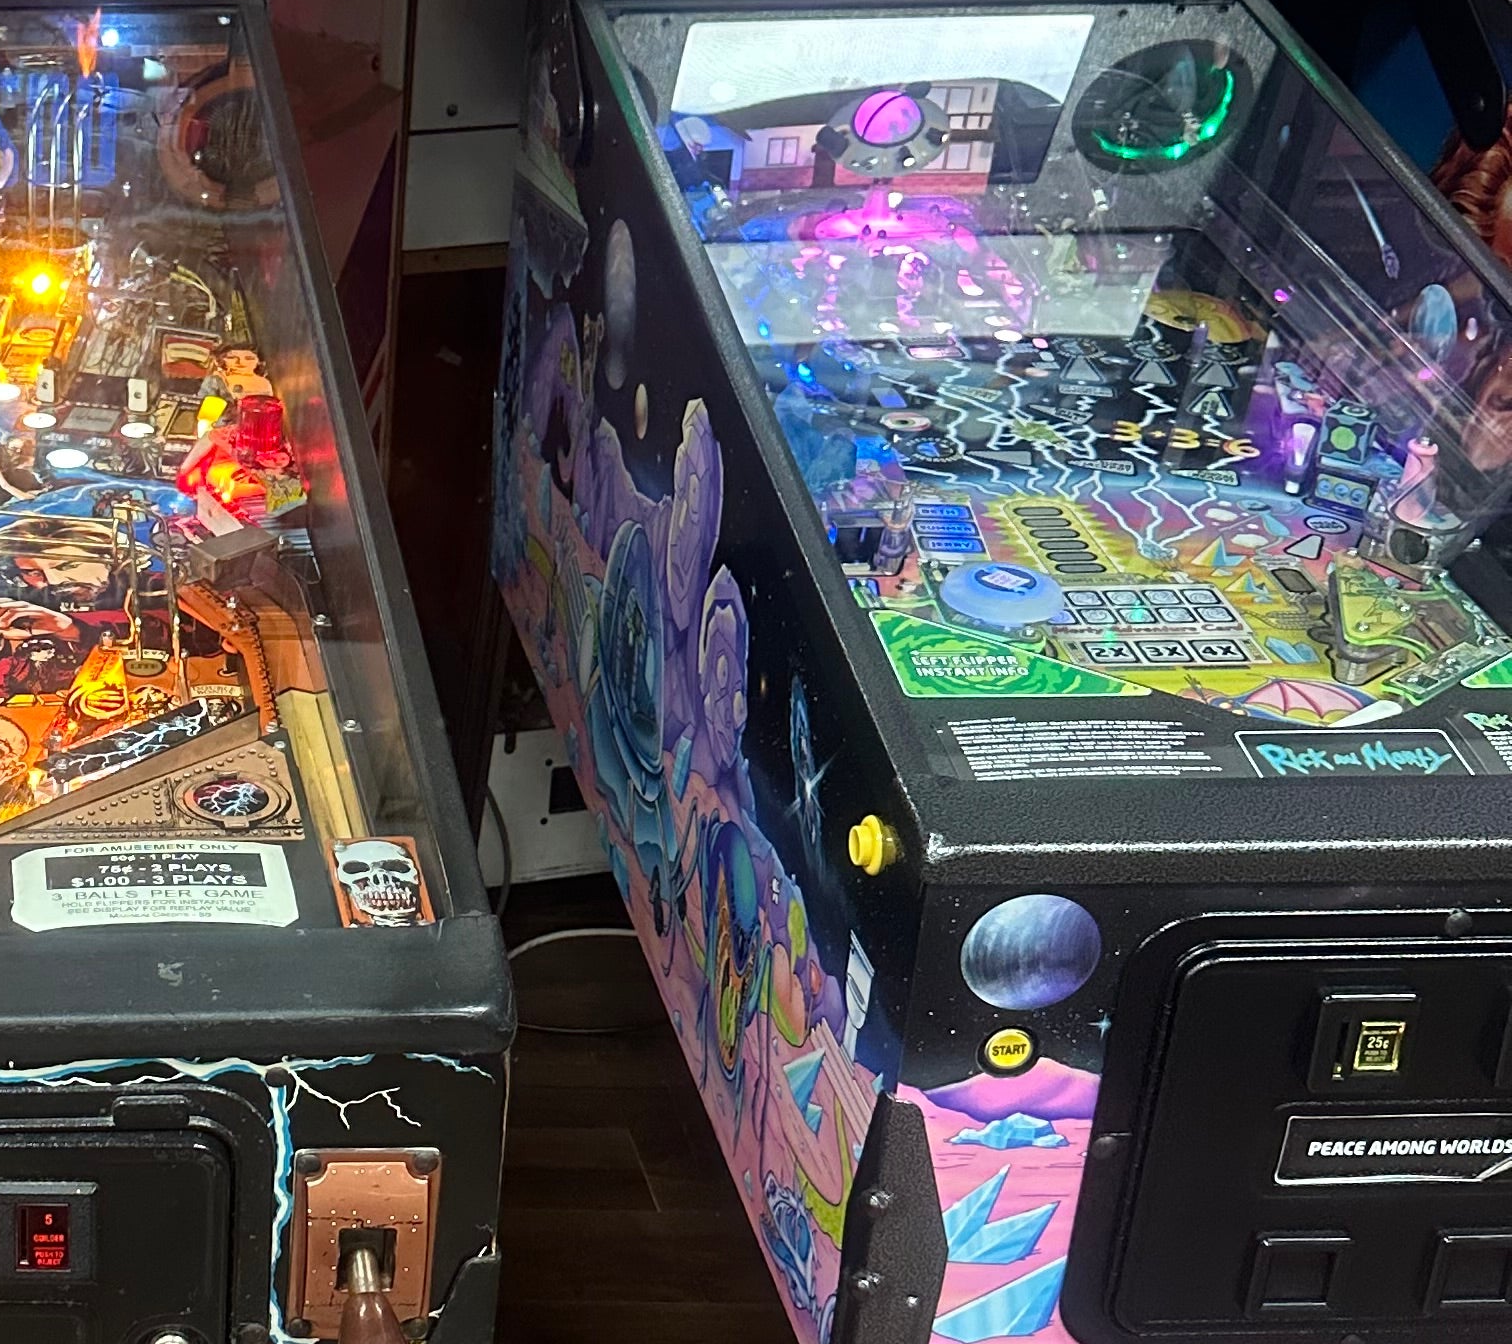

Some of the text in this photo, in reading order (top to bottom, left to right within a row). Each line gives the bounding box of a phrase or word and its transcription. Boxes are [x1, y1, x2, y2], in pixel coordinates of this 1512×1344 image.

[1089, 645, 1238, 658] 2X 3X 4X
[913, 654, 1018, 666] LEFT FLIPPER
[916, 665, 1029, 678] INSTANT INFO
[64, 843, 239, 855] FOR AMUSEMENT ONLY
[161, 853, 200, 862] PLAY
[150, 863, 163, 873] 2
[168, 863, 232, 873] PLAYS
[71, 875, 130, 888] $1.00
[153, 875, 165, 885] 3
[172, 874, 248, 886] PLAYS
[52, 888, 265, 901] 3 BALLS PER GAME
[991, 1040, 1028, 1059] START
[1308, 1138, 1512, 1156] PEACE AMONG WORLDS
[45, 1214, 53, 1226] 5
